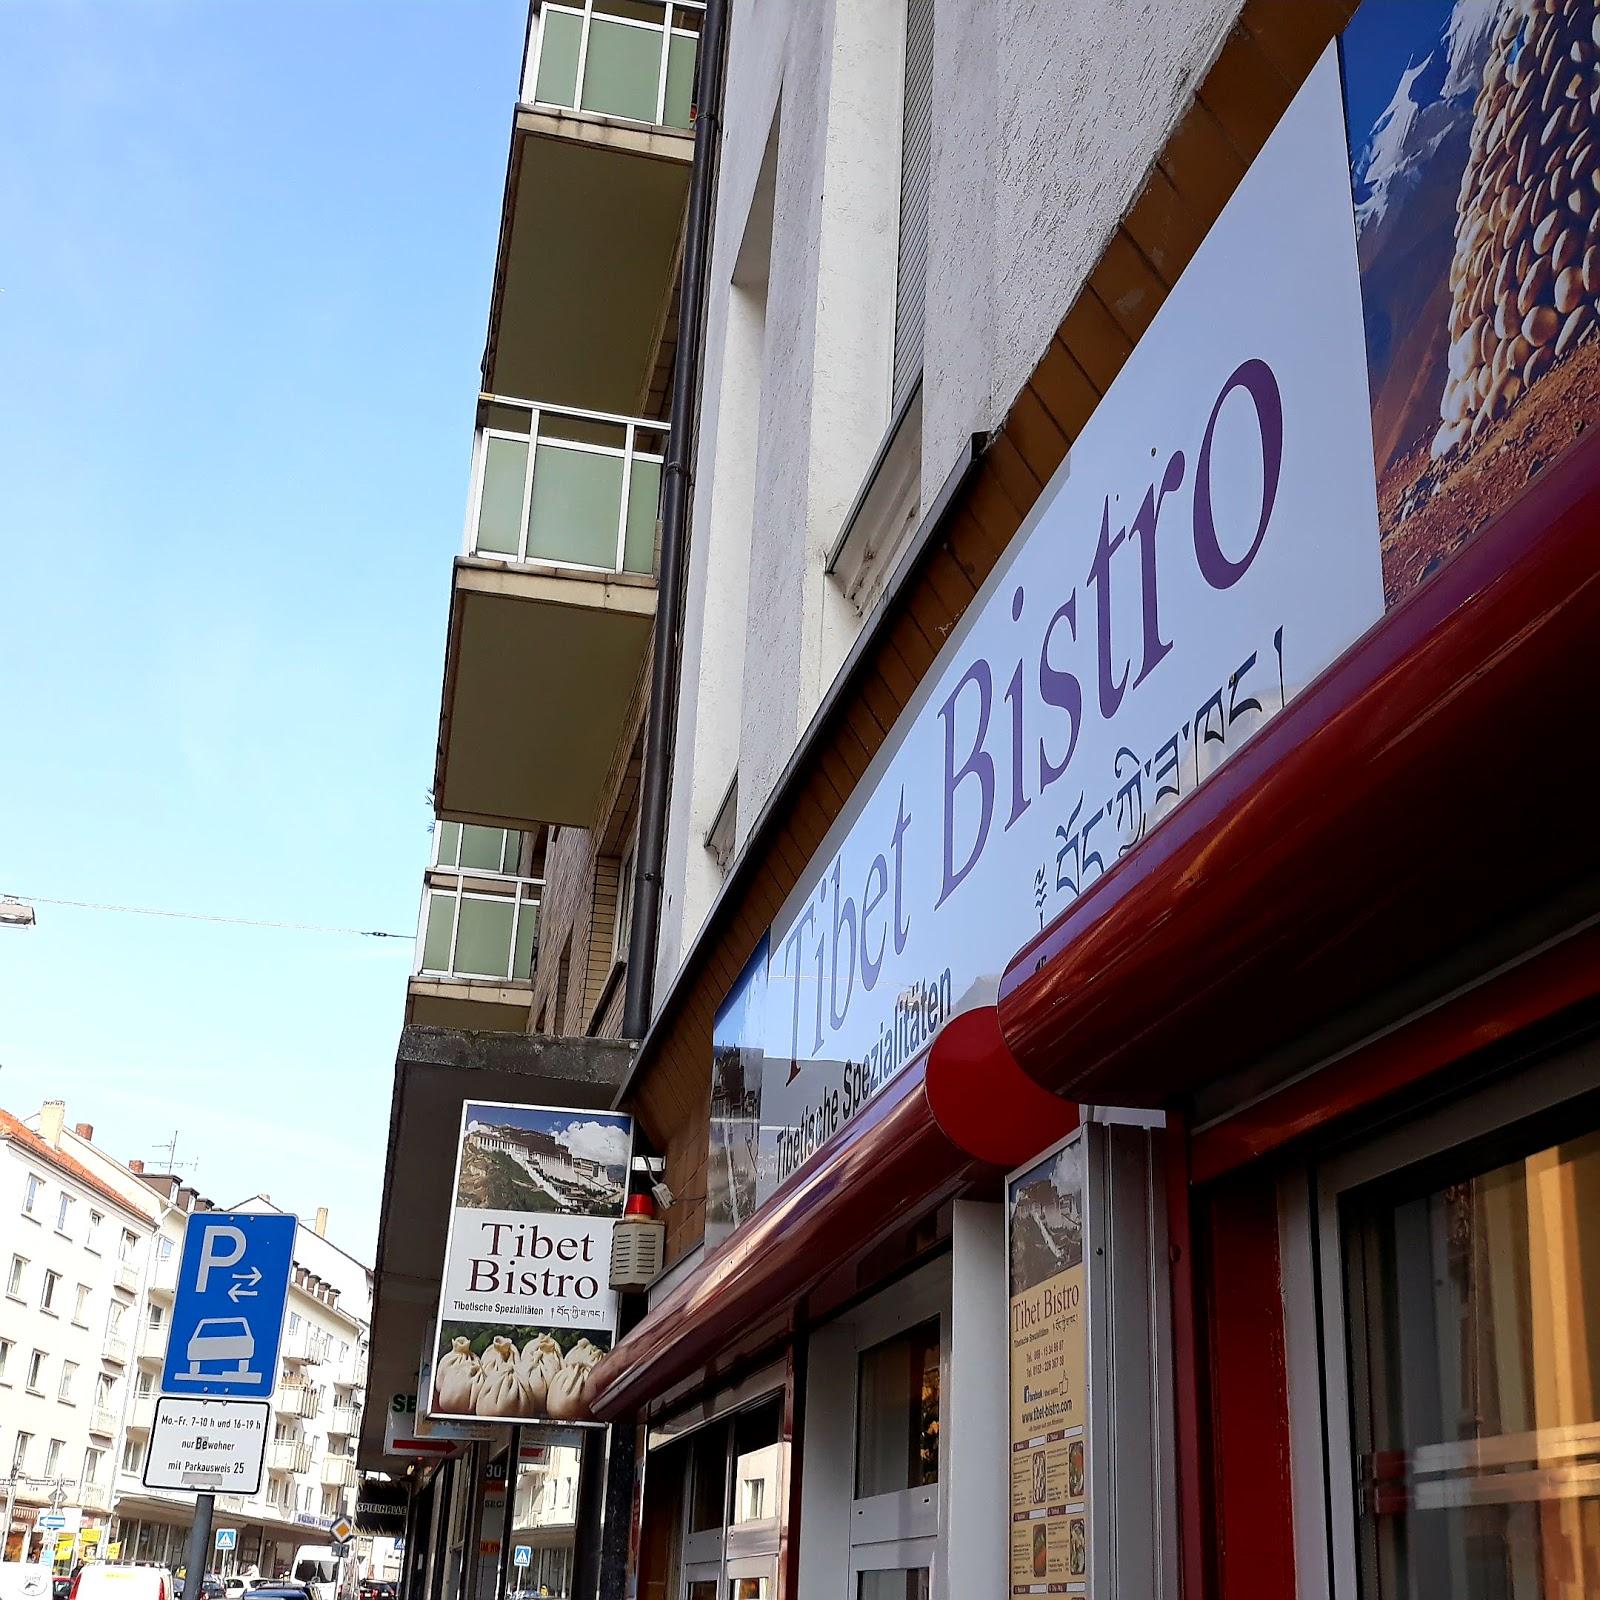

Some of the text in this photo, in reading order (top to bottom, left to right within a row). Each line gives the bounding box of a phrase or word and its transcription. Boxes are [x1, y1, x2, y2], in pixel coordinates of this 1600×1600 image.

[785, 358, 1283, 1086] Tibet Bistro
[776, 967, 951, 1183] Tibetische Spezialitäten
[195, 1225, 248, 1293] P
[481, 1222, 595, 1262] Tibet
[465, 1258, 599, 1300] Bistro
[453, 1301, 544, 1315] Tibetische Spezialitäten
[1013, 1297, 1041, 1332] Tibet
[1044, 1284, 1079, 1319] Bistro
[161, 1414, 261, 1430] Mo.-Fr. 7-10 h und 16-19 h
[181, 1436, 235, 1450] nur Bewohner
[168, 1460, 245, 1474] mit Parkausweis 25
[357, 1502, 408, 1516] SPIELHALLE
